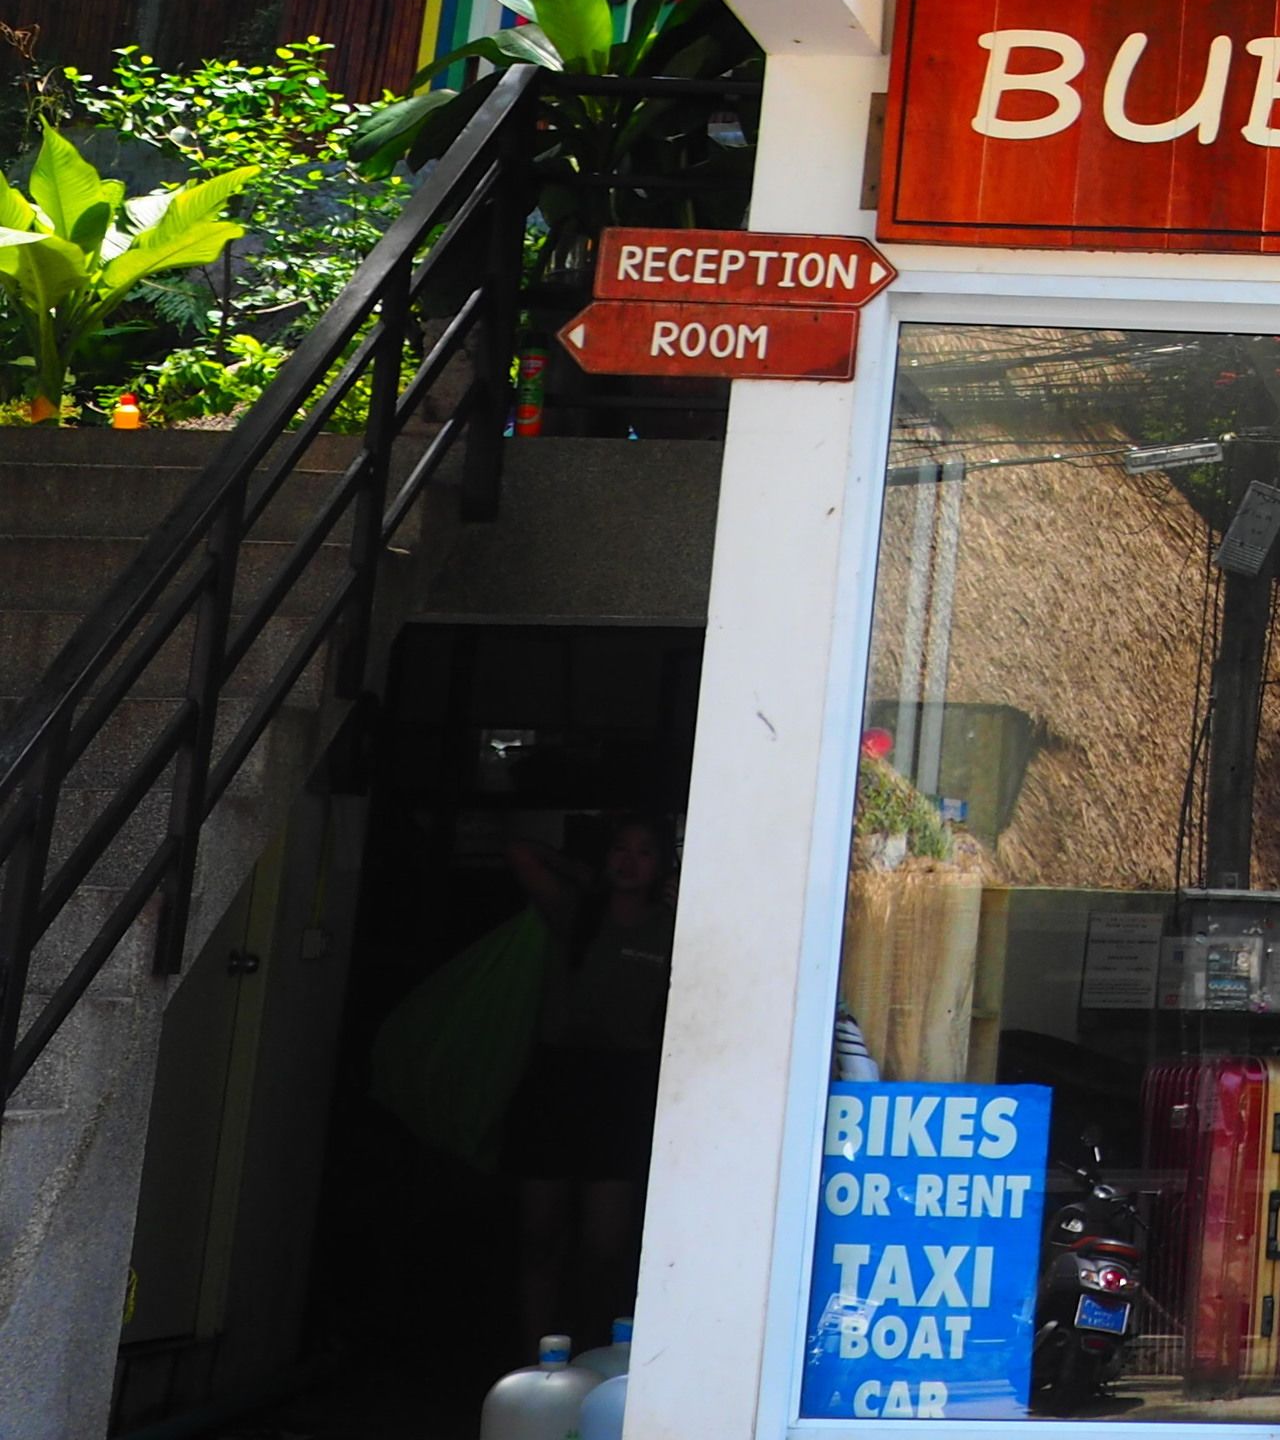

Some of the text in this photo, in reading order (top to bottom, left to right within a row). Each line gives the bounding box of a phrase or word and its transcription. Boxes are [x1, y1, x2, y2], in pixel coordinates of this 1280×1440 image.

[616, 245, 859, 290] RECEPTION
[650, 321, 769, 360] ROOM
[824, 1096, 1019, 1159] BIKES
[824, 1172, 1031, 1218] OR RENT
[833, 1244, 994, 1308] TAXI
[839, 1316, 971, 1361] BOAT
[853, 1380, 949, 1419] CAR
